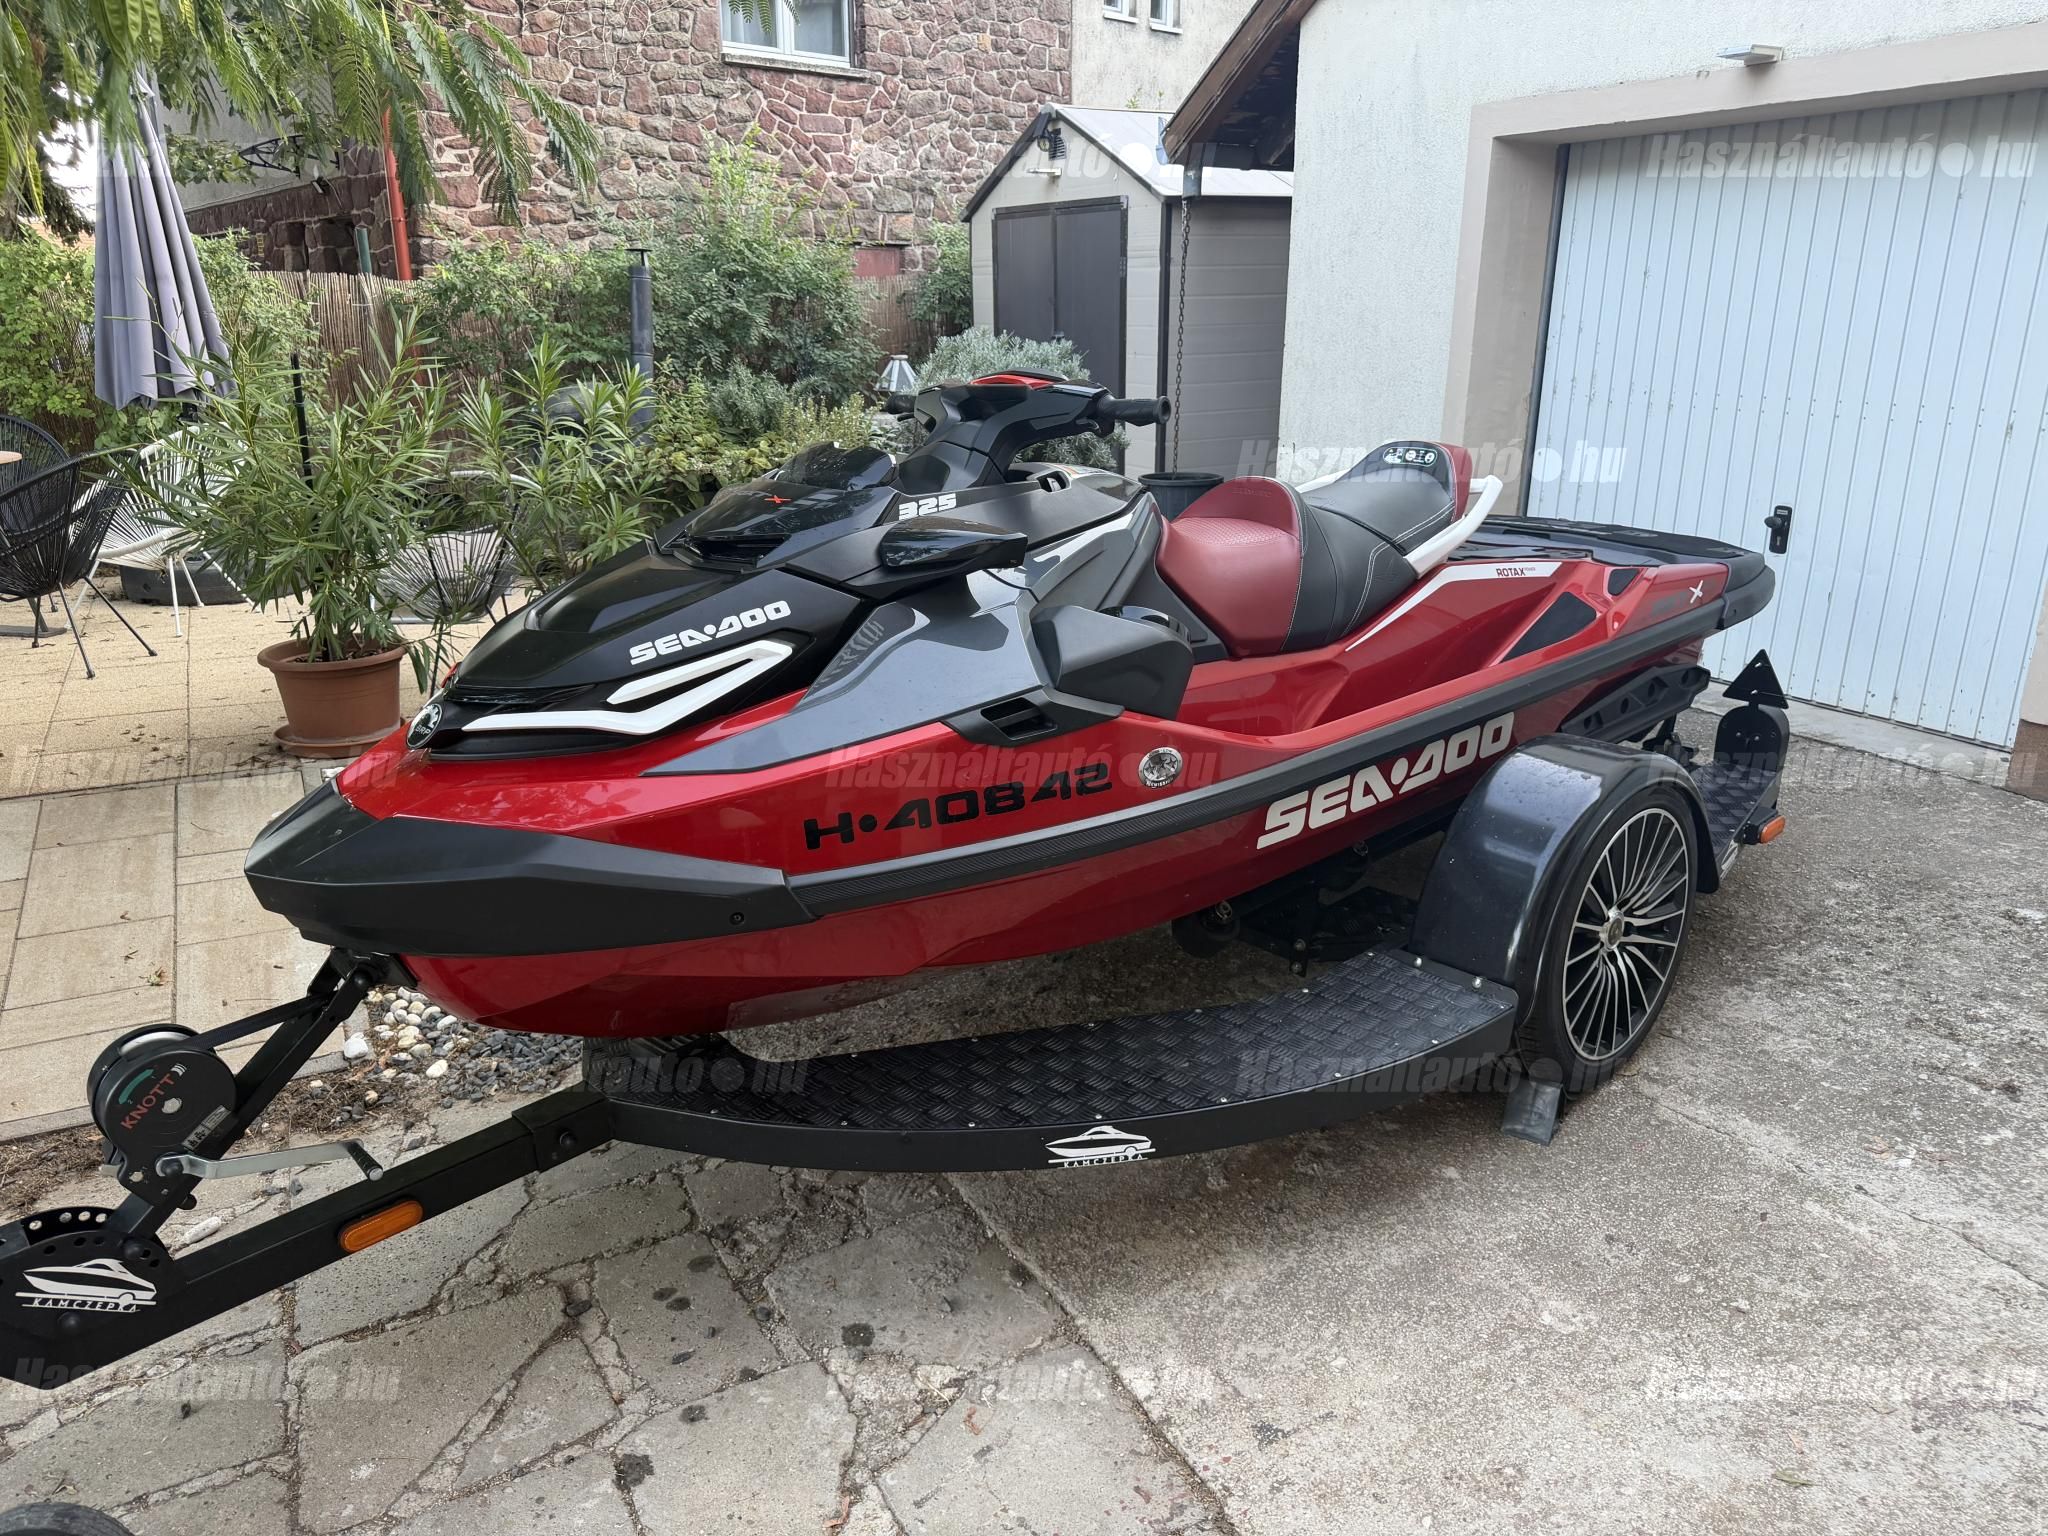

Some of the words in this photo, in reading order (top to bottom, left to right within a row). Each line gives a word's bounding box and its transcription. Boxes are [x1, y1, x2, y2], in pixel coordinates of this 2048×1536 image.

[898, 493, 957, 521] 325
[1495, 567, 1526, 577] ROTAX
[414, 724, 432, 736] BRP
[121, 1073, 175, 1129] KNOTT
